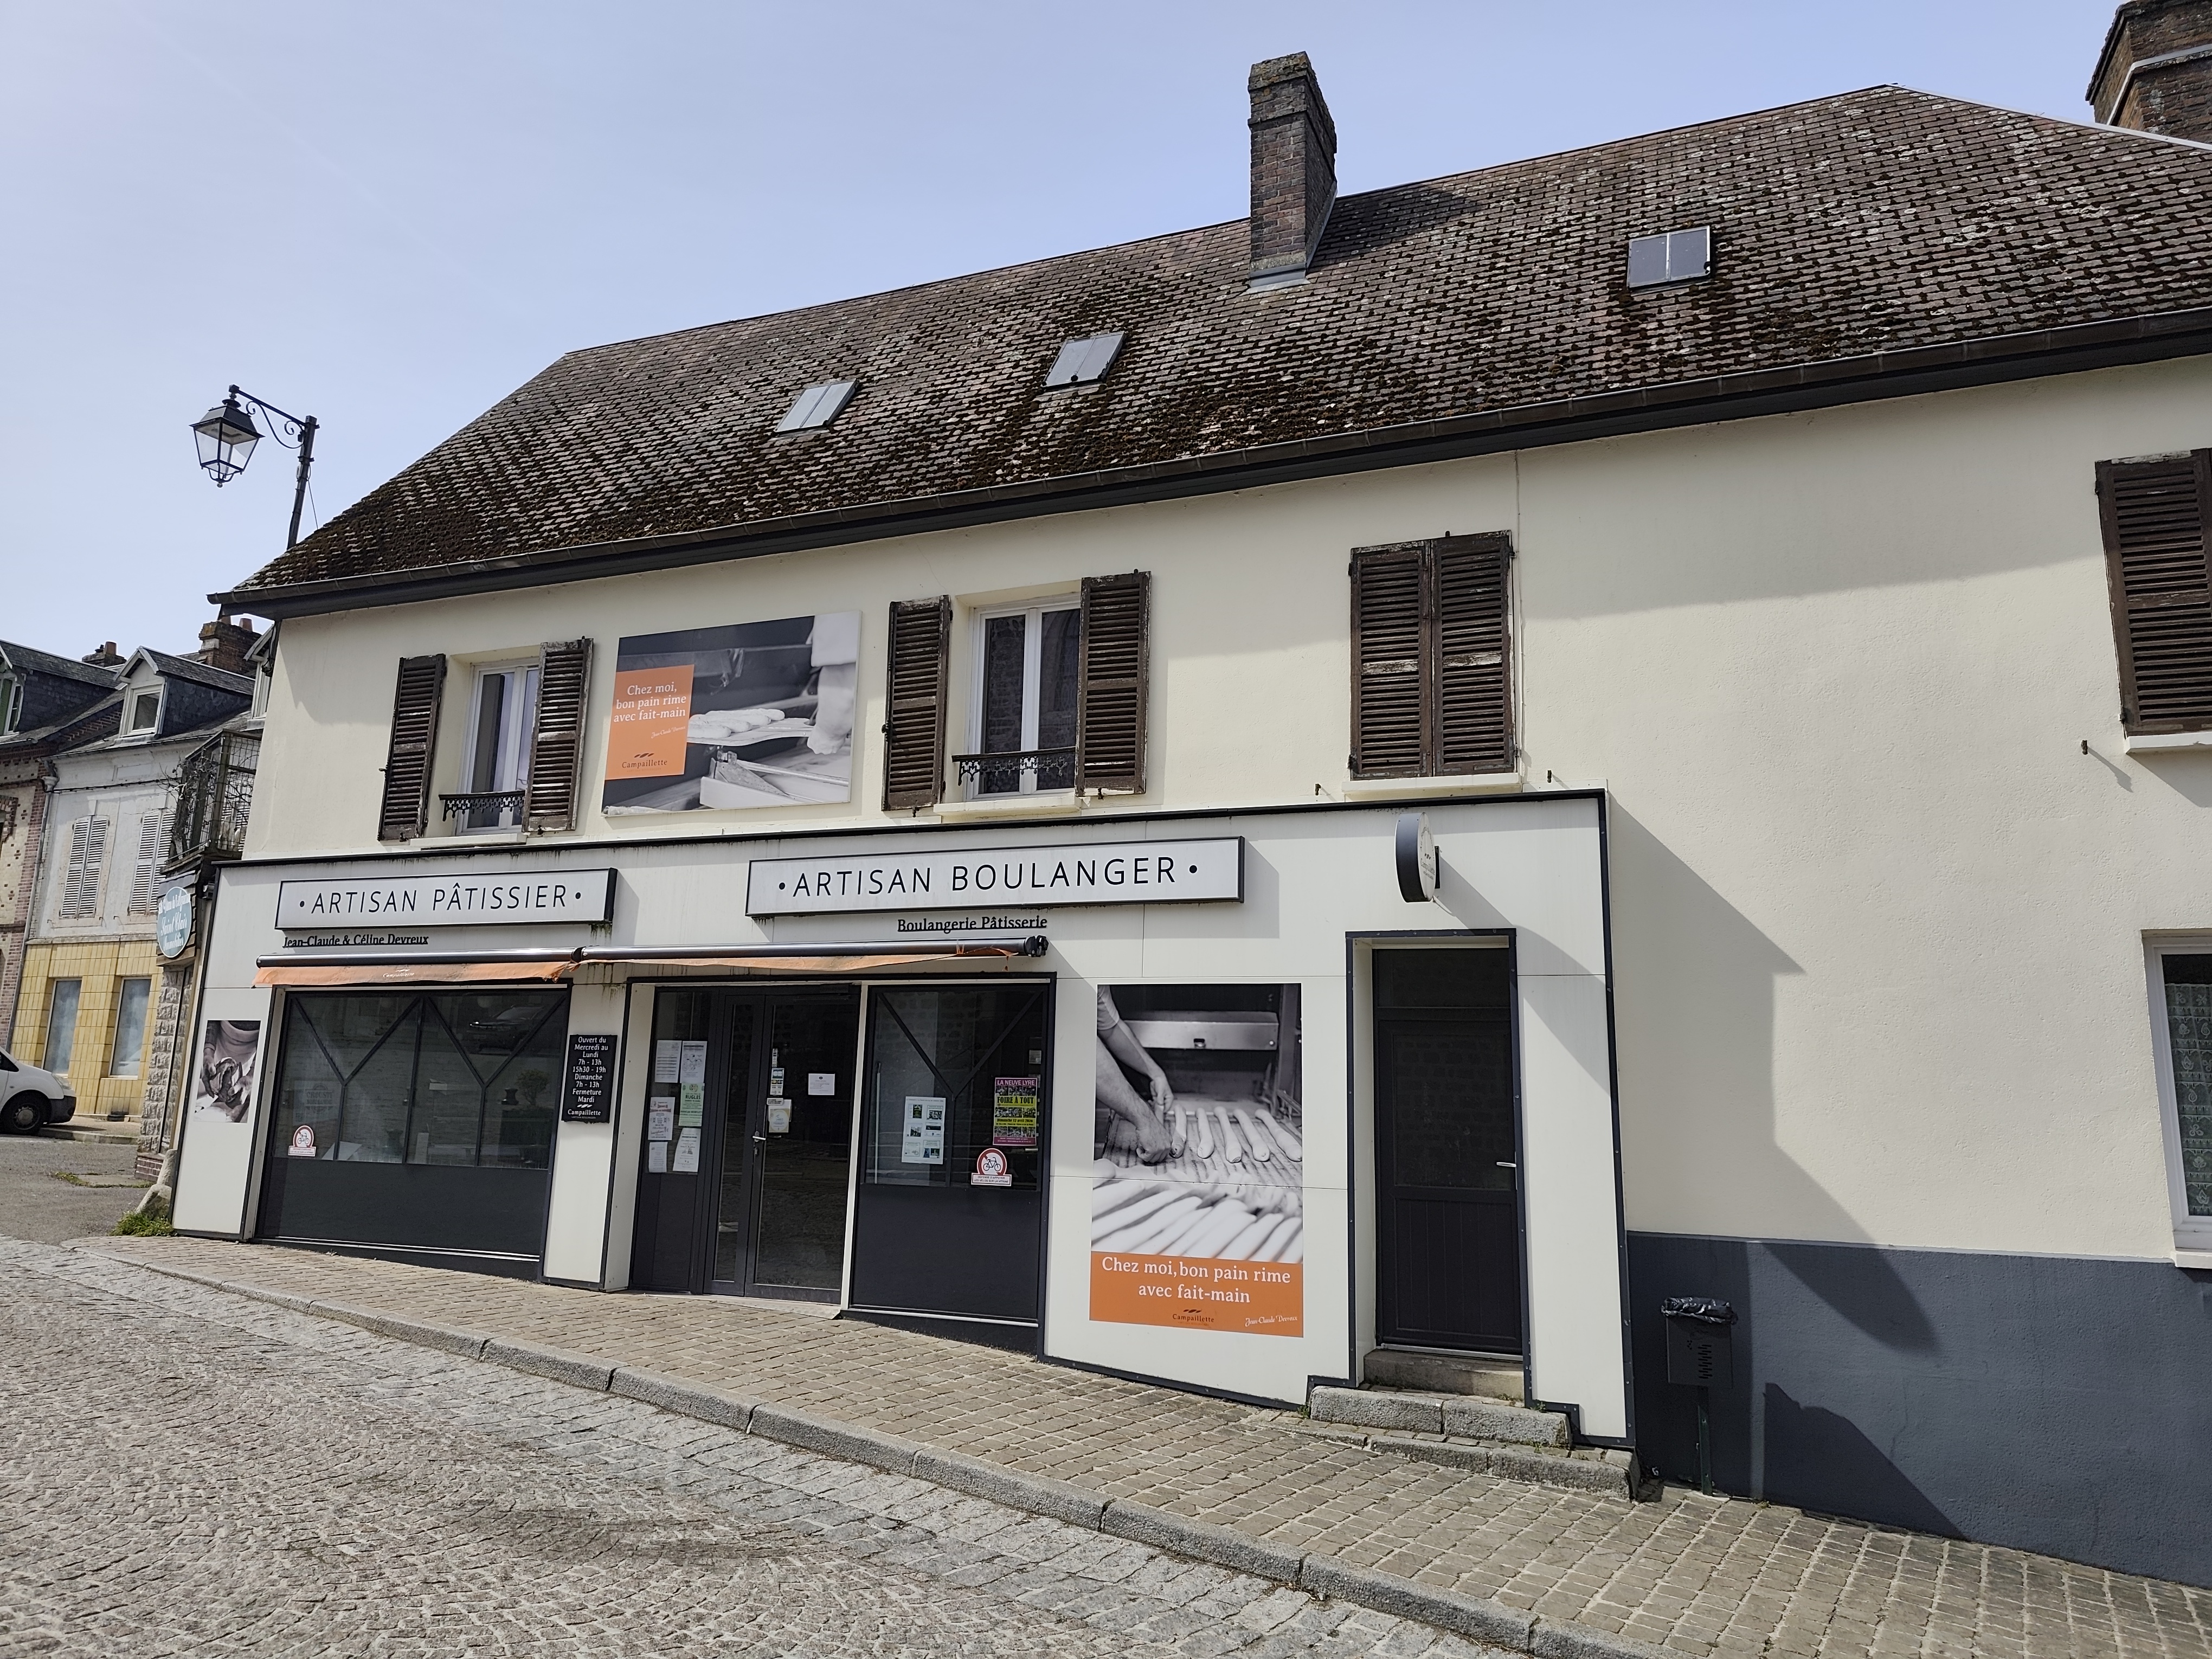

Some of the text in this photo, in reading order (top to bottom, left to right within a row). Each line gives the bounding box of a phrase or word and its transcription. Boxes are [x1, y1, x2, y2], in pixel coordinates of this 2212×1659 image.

[627, 681, 677, 696] Chez moi,
[616, 695, 686, 710] bon pain rime
[614, 707, 685, 722] avec fait-main
[622, 760, 667, 769] Campaillette
[793, 857, 1175, 897] ARTISAN BOULANGER
[311, 882, 566, 914] ARTISAN PÂTISSIER
[897, 915, 1047, 934] Boulangerie Pâtisserie
[282, 934, 429, 948] Jean-Claude & Céline Devreux
[1014, 1095, 1018, 1103] À
[1102, 1256, 1290, 1283] Chez moi, bon pain rime
[1139, 1284, 1250, 1303] avec fait-main
[1172, 1314, 1214, 1323] Campaillette
[1245, 1315, 1275, 1327] Jean-Claude
